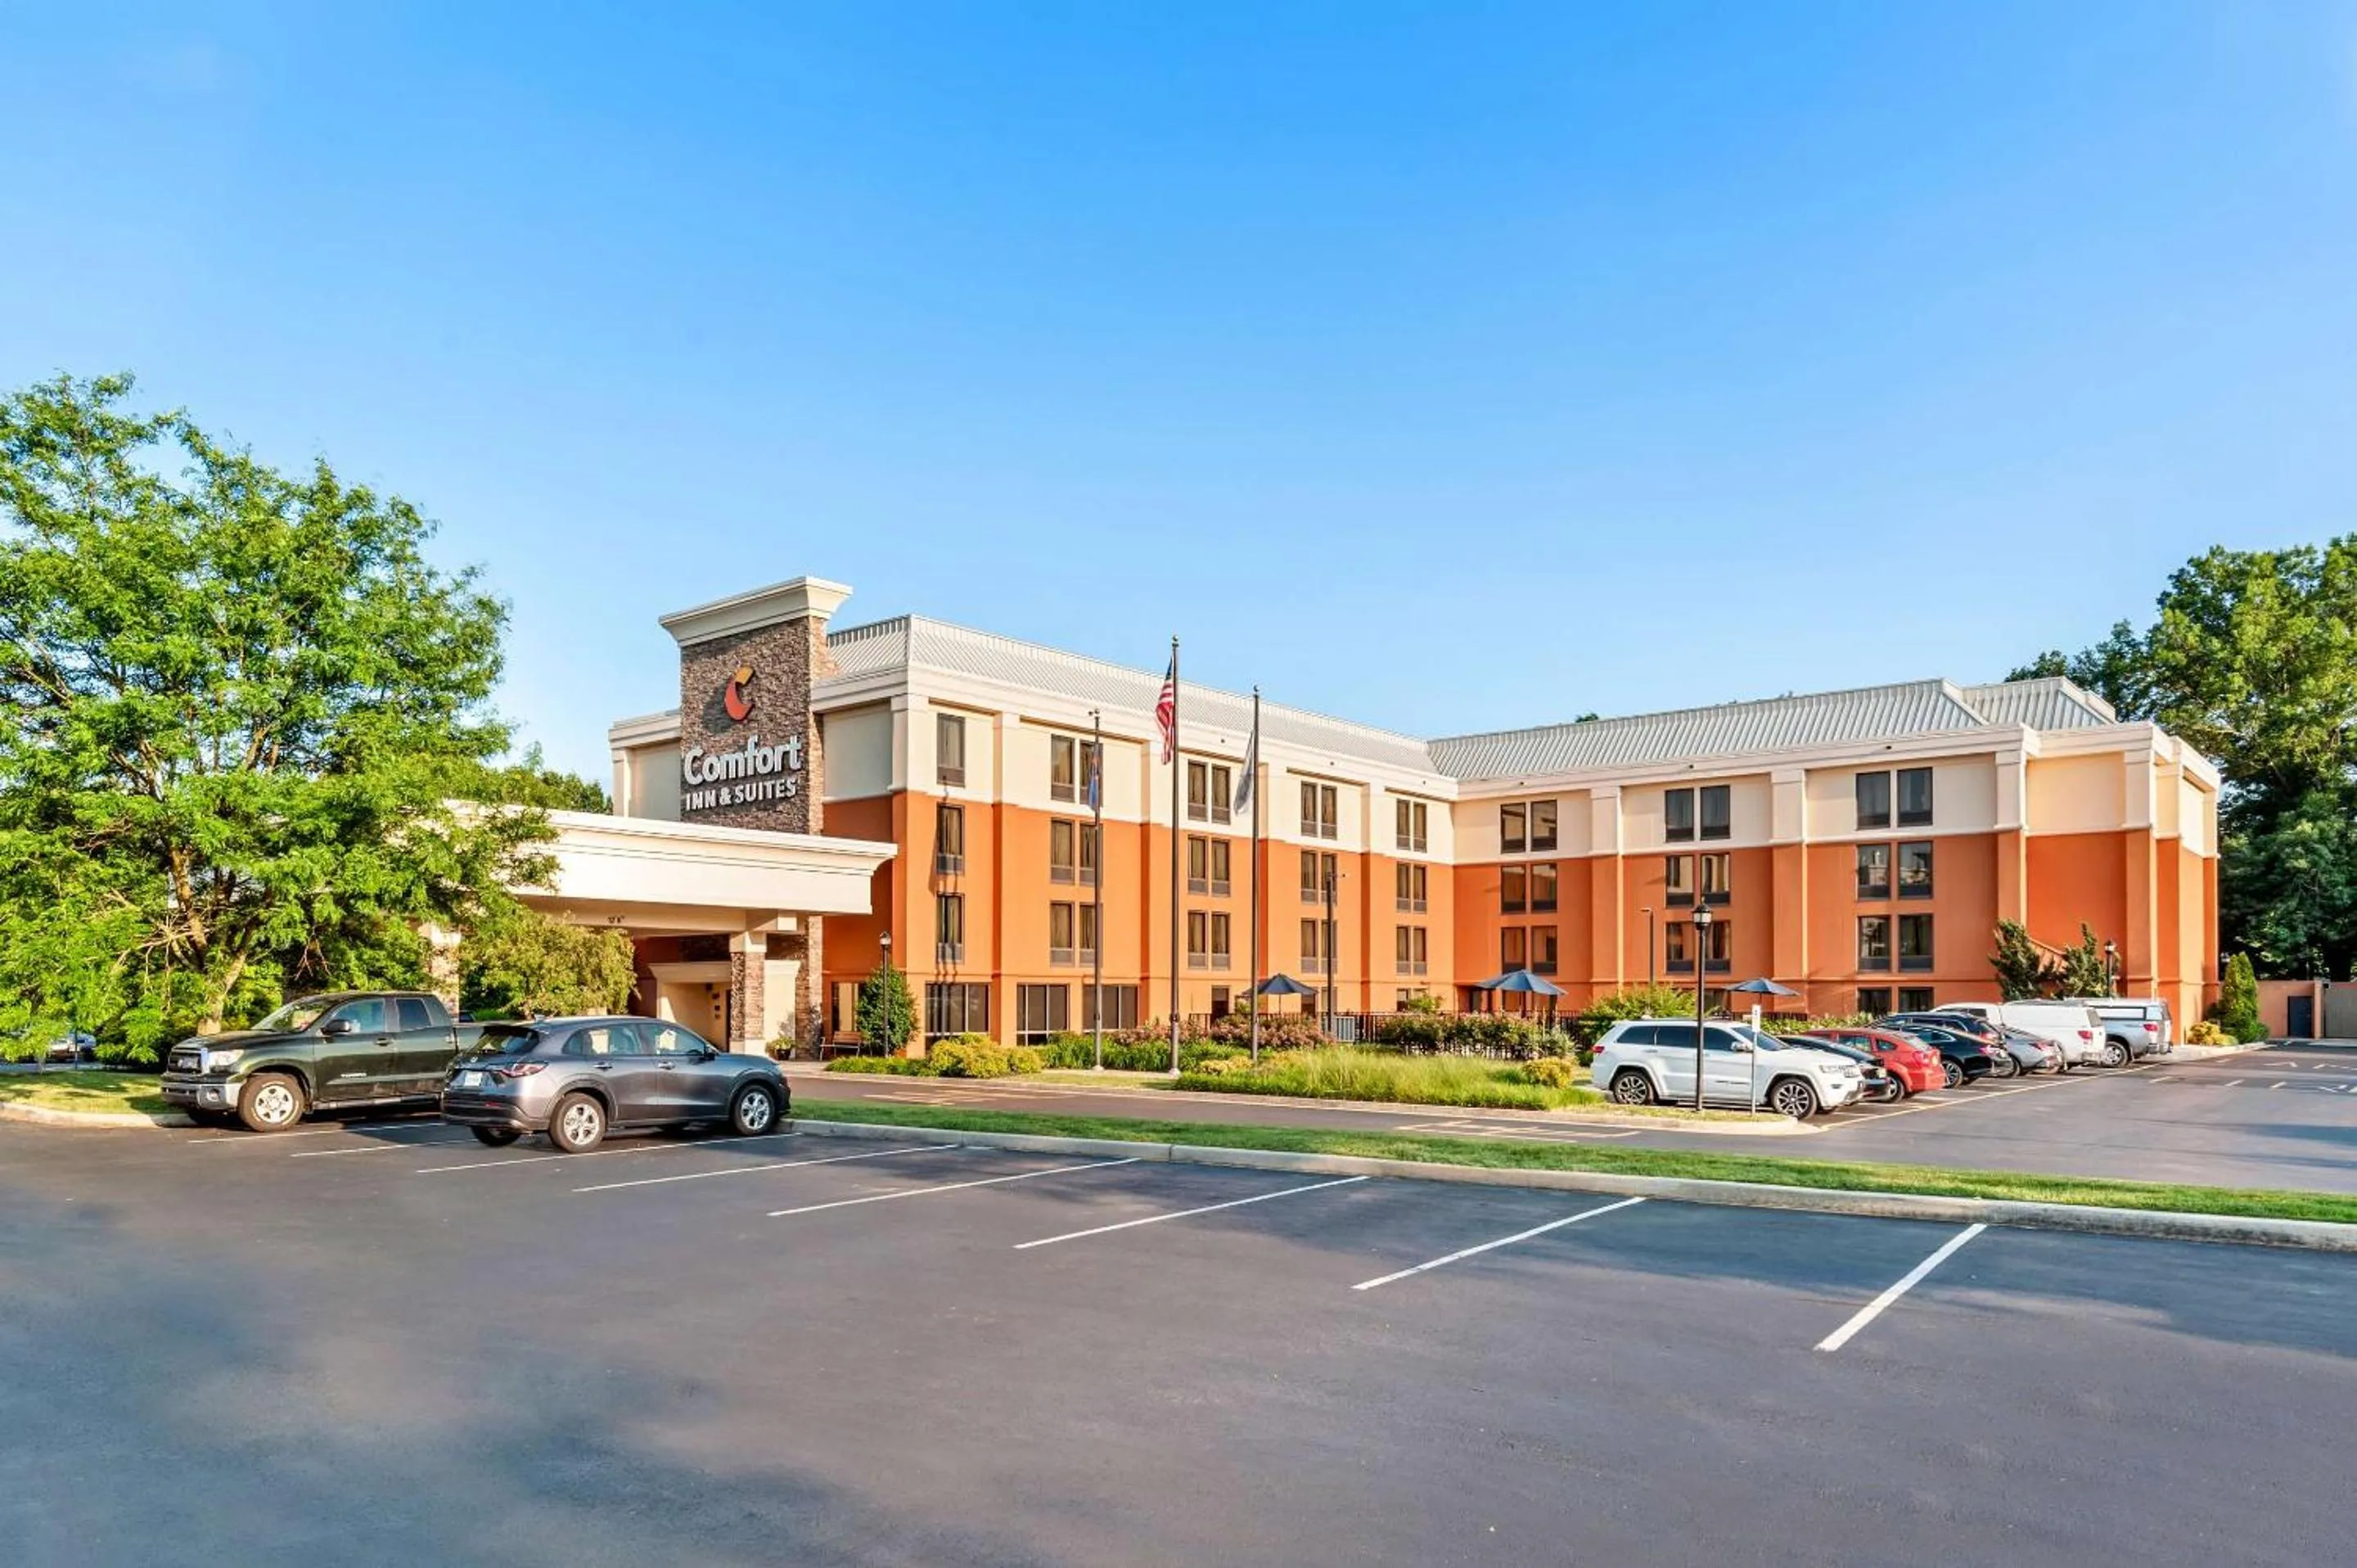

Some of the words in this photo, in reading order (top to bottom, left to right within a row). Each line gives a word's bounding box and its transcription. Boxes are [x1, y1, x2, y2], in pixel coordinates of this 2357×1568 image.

[684, 735, 802, 785] Comfort
[686, 790, 717, 811] INN
[735, 778, 797, 803] SUITES
